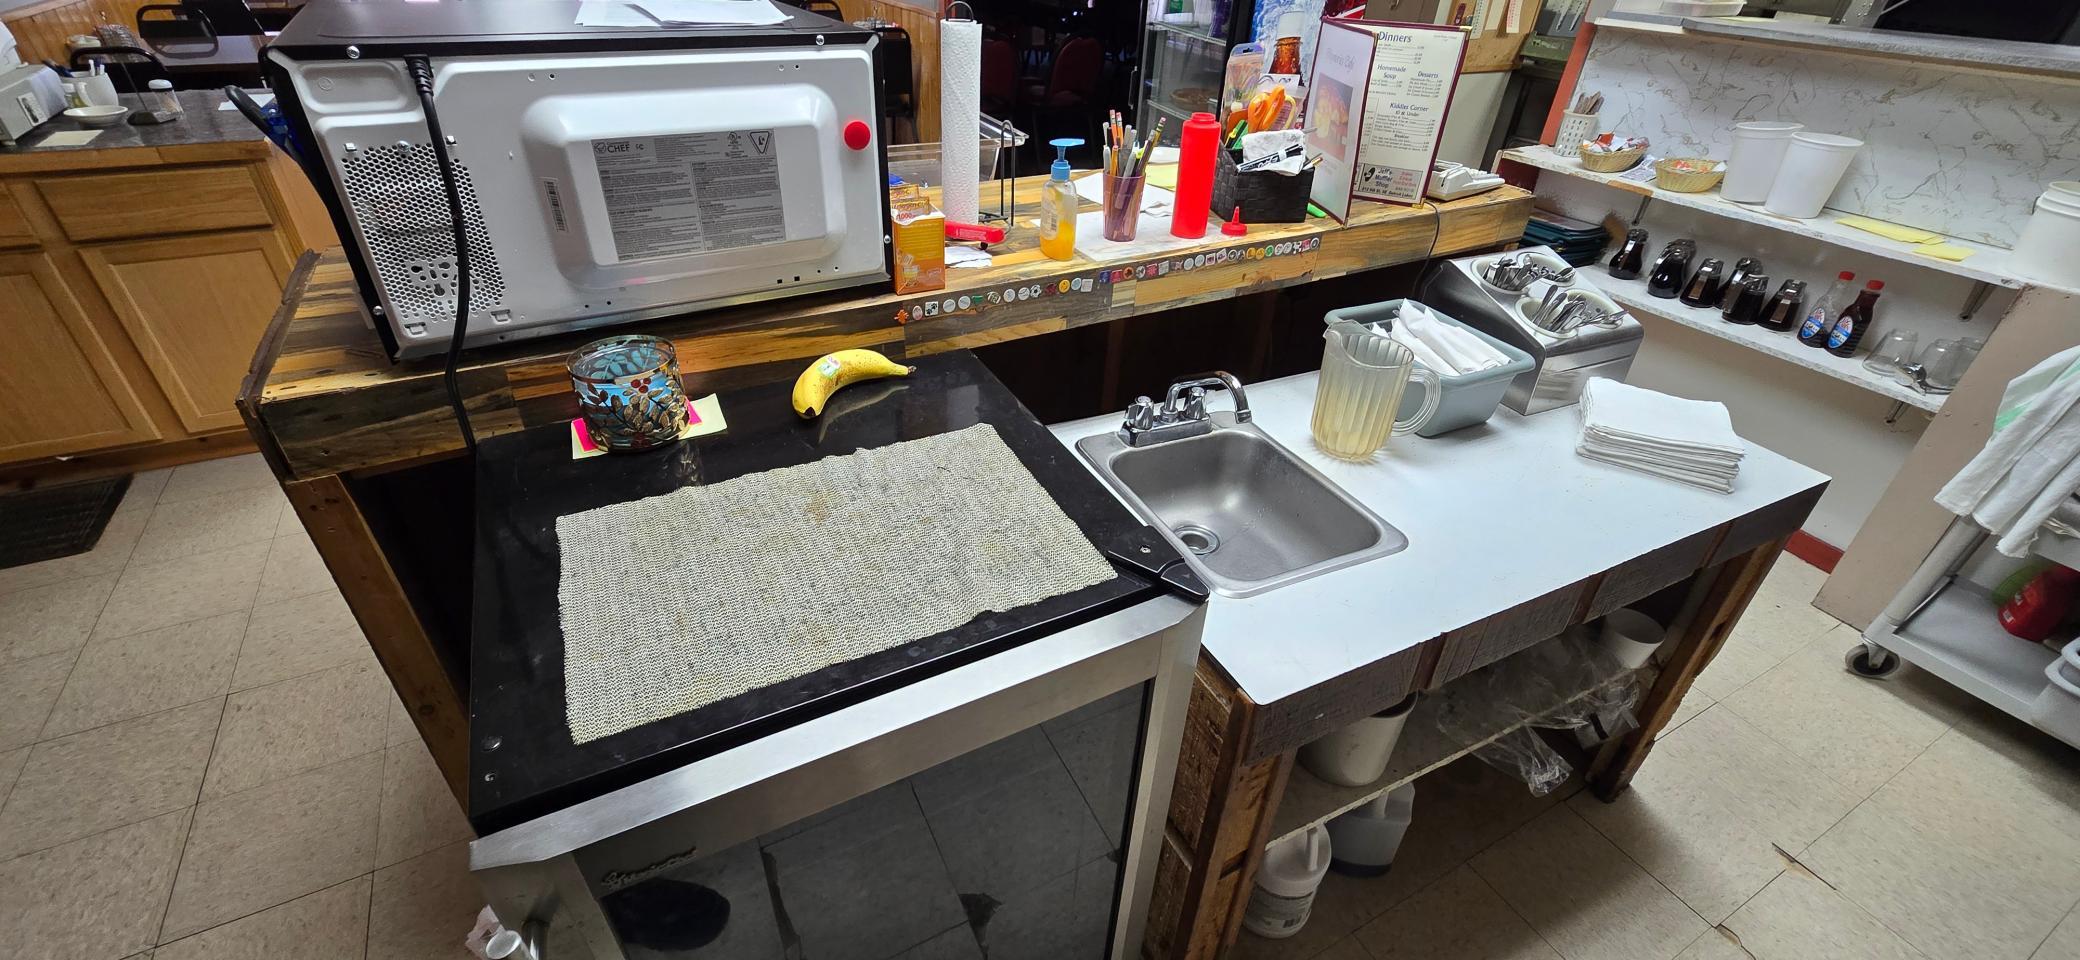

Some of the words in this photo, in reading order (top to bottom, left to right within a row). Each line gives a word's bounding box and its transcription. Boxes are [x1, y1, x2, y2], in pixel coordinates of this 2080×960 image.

[1378, 31, 1413, 43] Dinners
[1377, 64, 1406, 73] Homemade
[1383, 72, 1397, 80] Soup
[1417, 70, 1439, 78] Desserts
[1410, 104, 1429, 112] Corner
[607, 144, 630, 153] CHEF
